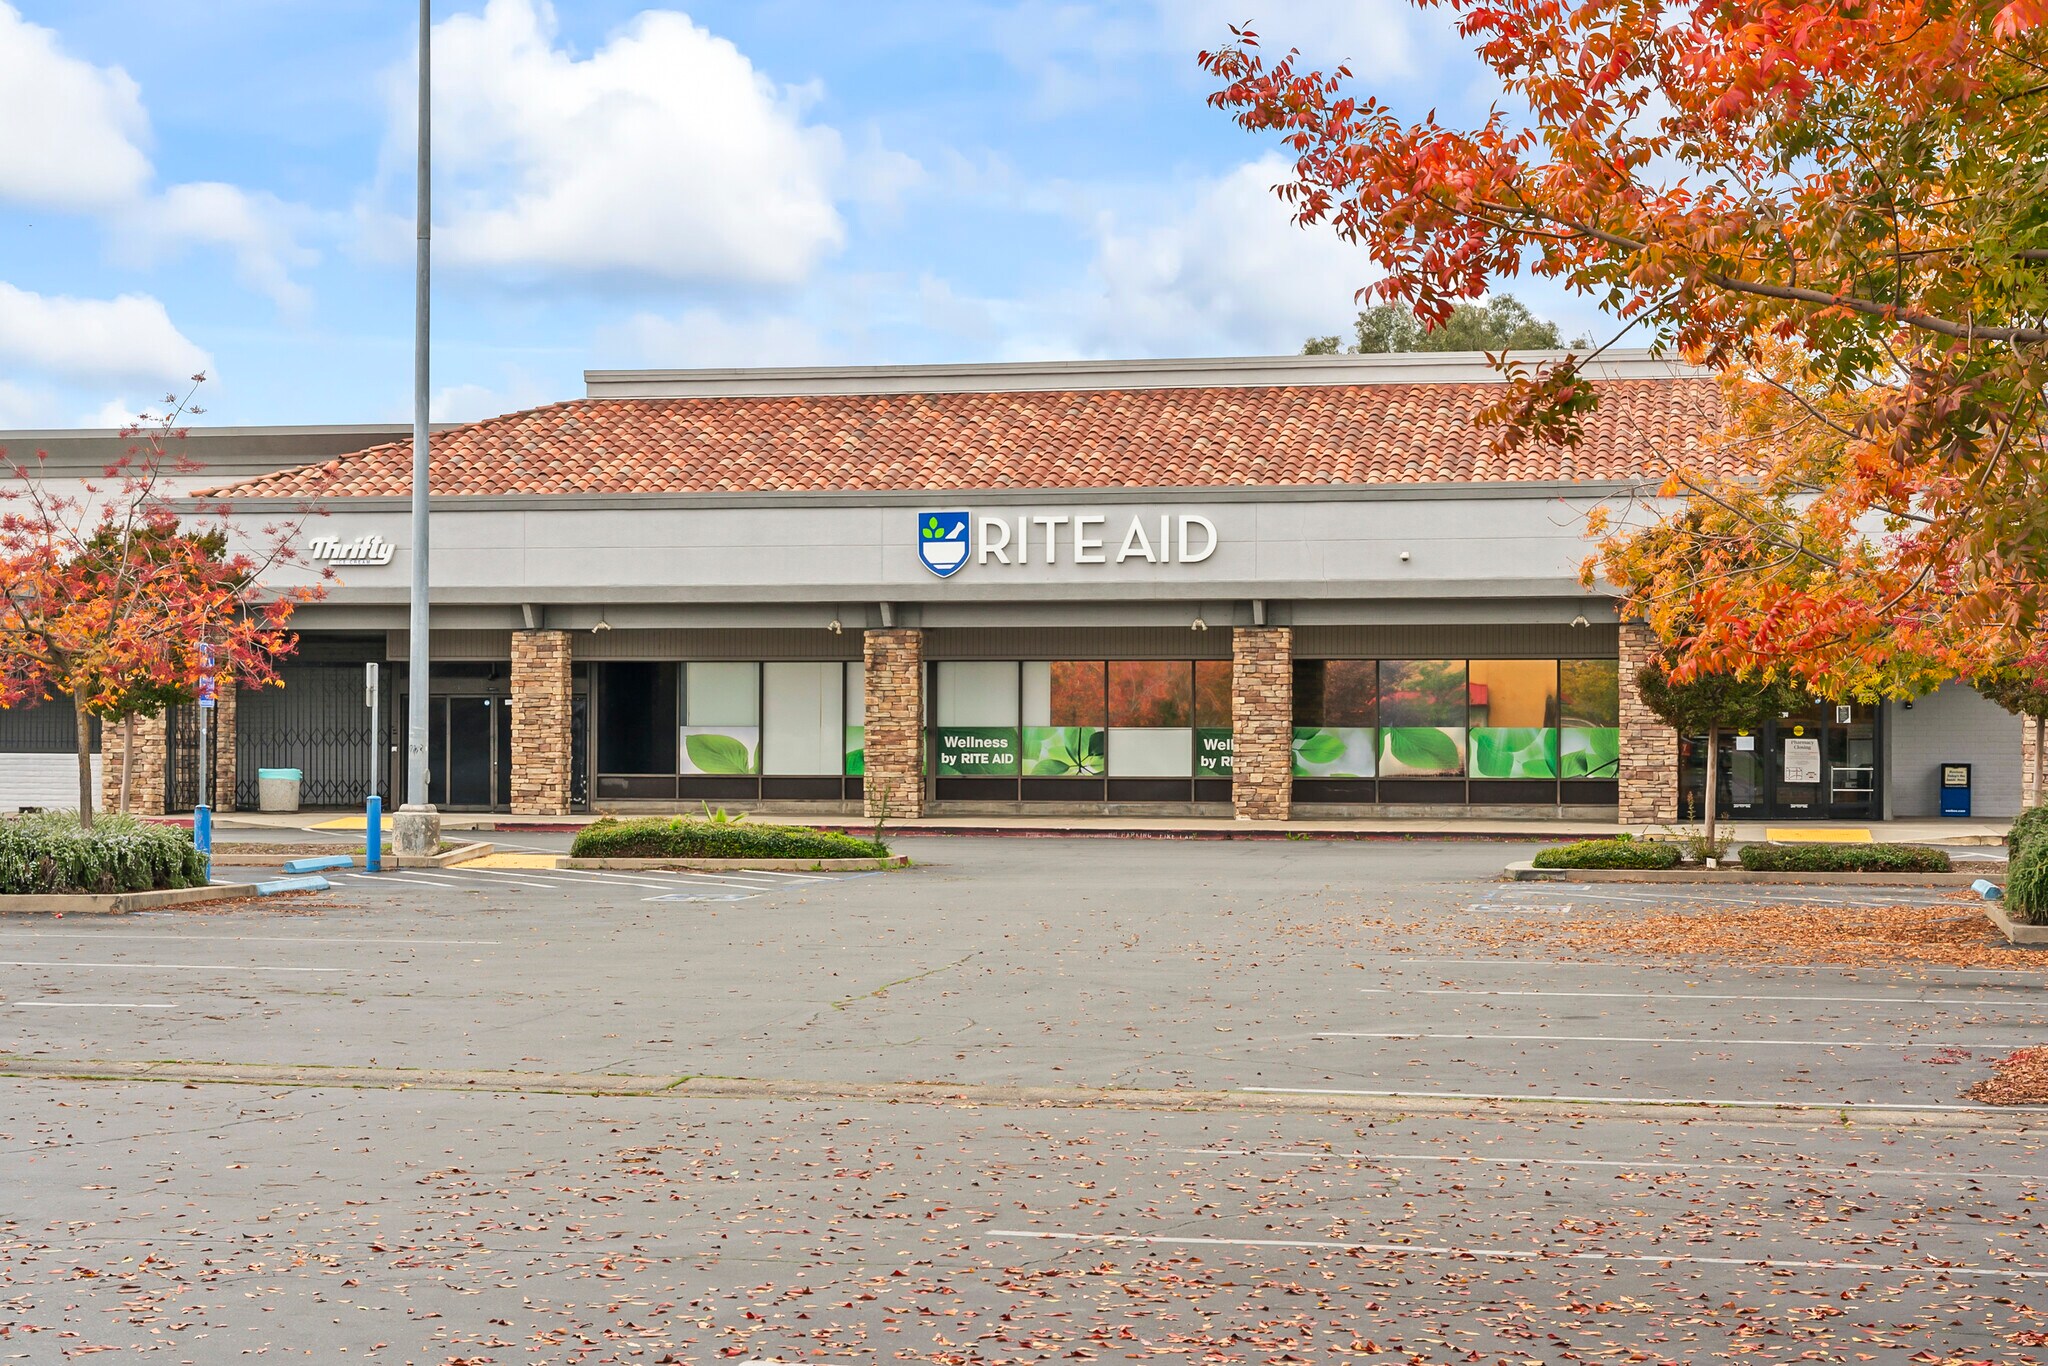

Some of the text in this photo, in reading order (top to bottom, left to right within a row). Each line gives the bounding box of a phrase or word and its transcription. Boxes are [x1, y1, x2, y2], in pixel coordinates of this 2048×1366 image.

[978, 513, 1218, 565] RITE AID
[309, 535, 396, 566] Thrifty
[944, 736, 1008, 748] Wellness
[941, 753, 1014, 766] by RITE AID
[1201, 755, 1217, 769] by
